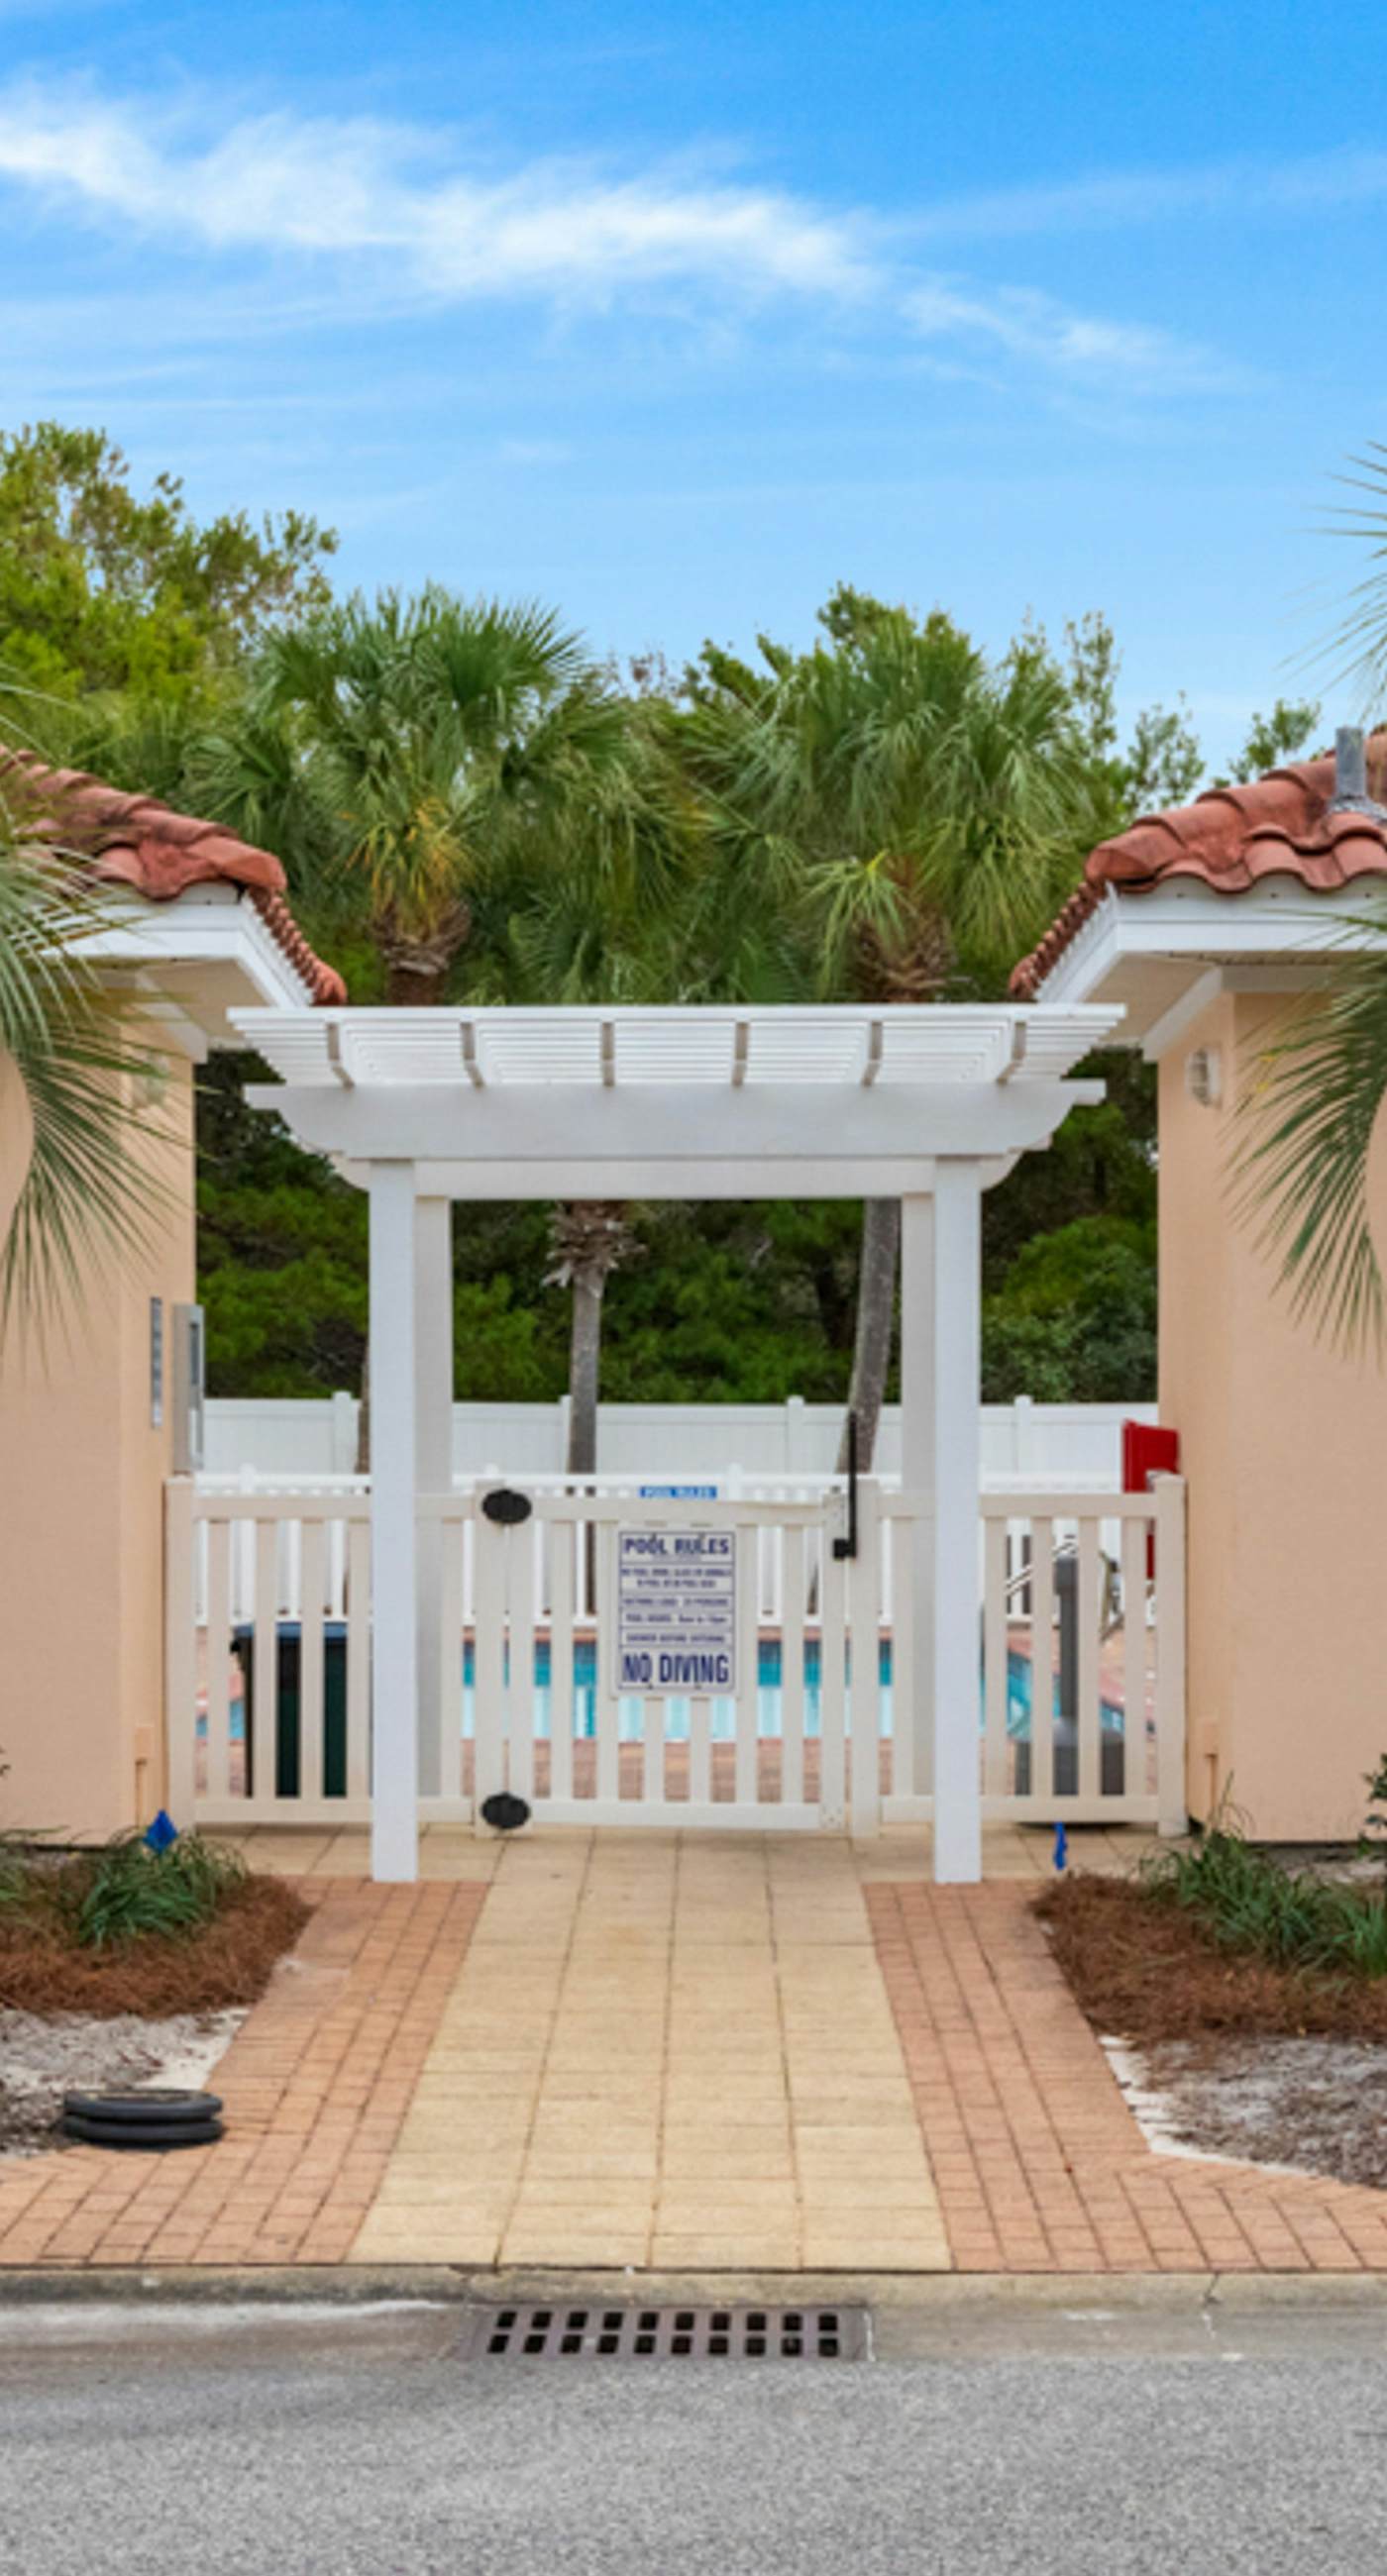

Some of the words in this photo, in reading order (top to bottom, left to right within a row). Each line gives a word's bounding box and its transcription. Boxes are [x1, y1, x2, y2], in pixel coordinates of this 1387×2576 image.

[624, 1538, 668, 1554] POOL
[675, 1538, 729, 1554] RULES
[622, 1654, 653, 1683] NO
[660, 1654, 729, 1683] DIVING
